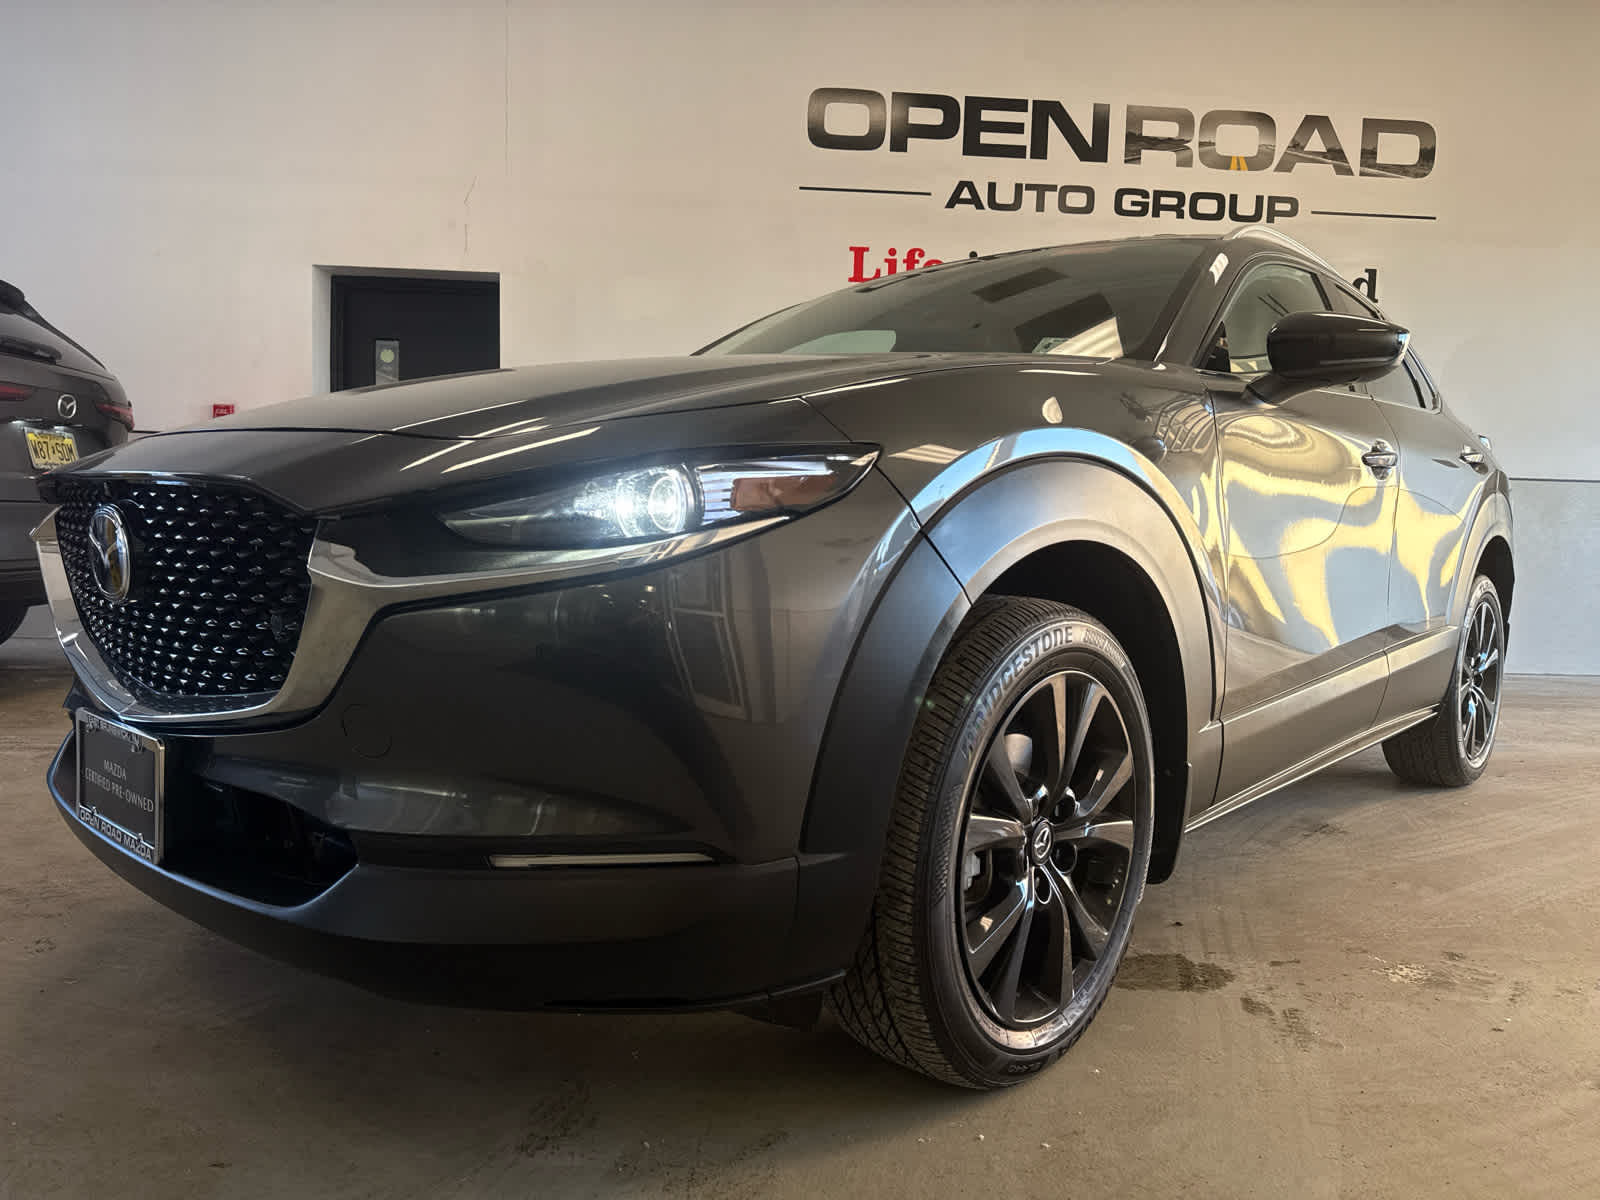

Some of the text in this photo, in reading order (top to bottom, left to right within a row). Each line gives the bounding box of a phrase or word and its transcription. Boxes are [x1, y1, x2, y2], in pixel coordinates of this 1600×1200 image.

[807, 87, 1437, 179] OPEN ROAD
[945, 180, 1299, 223] AUTO GROUP
[848, 246, 945, 283] Lif
[85, 767, 154, 812] CERTIFIED PRE-OWNED
[103, 759, 127, 781] MAZDA
[101, 821, 122, 843] ROAD
[123, 834, 152, 861] MAZDA
